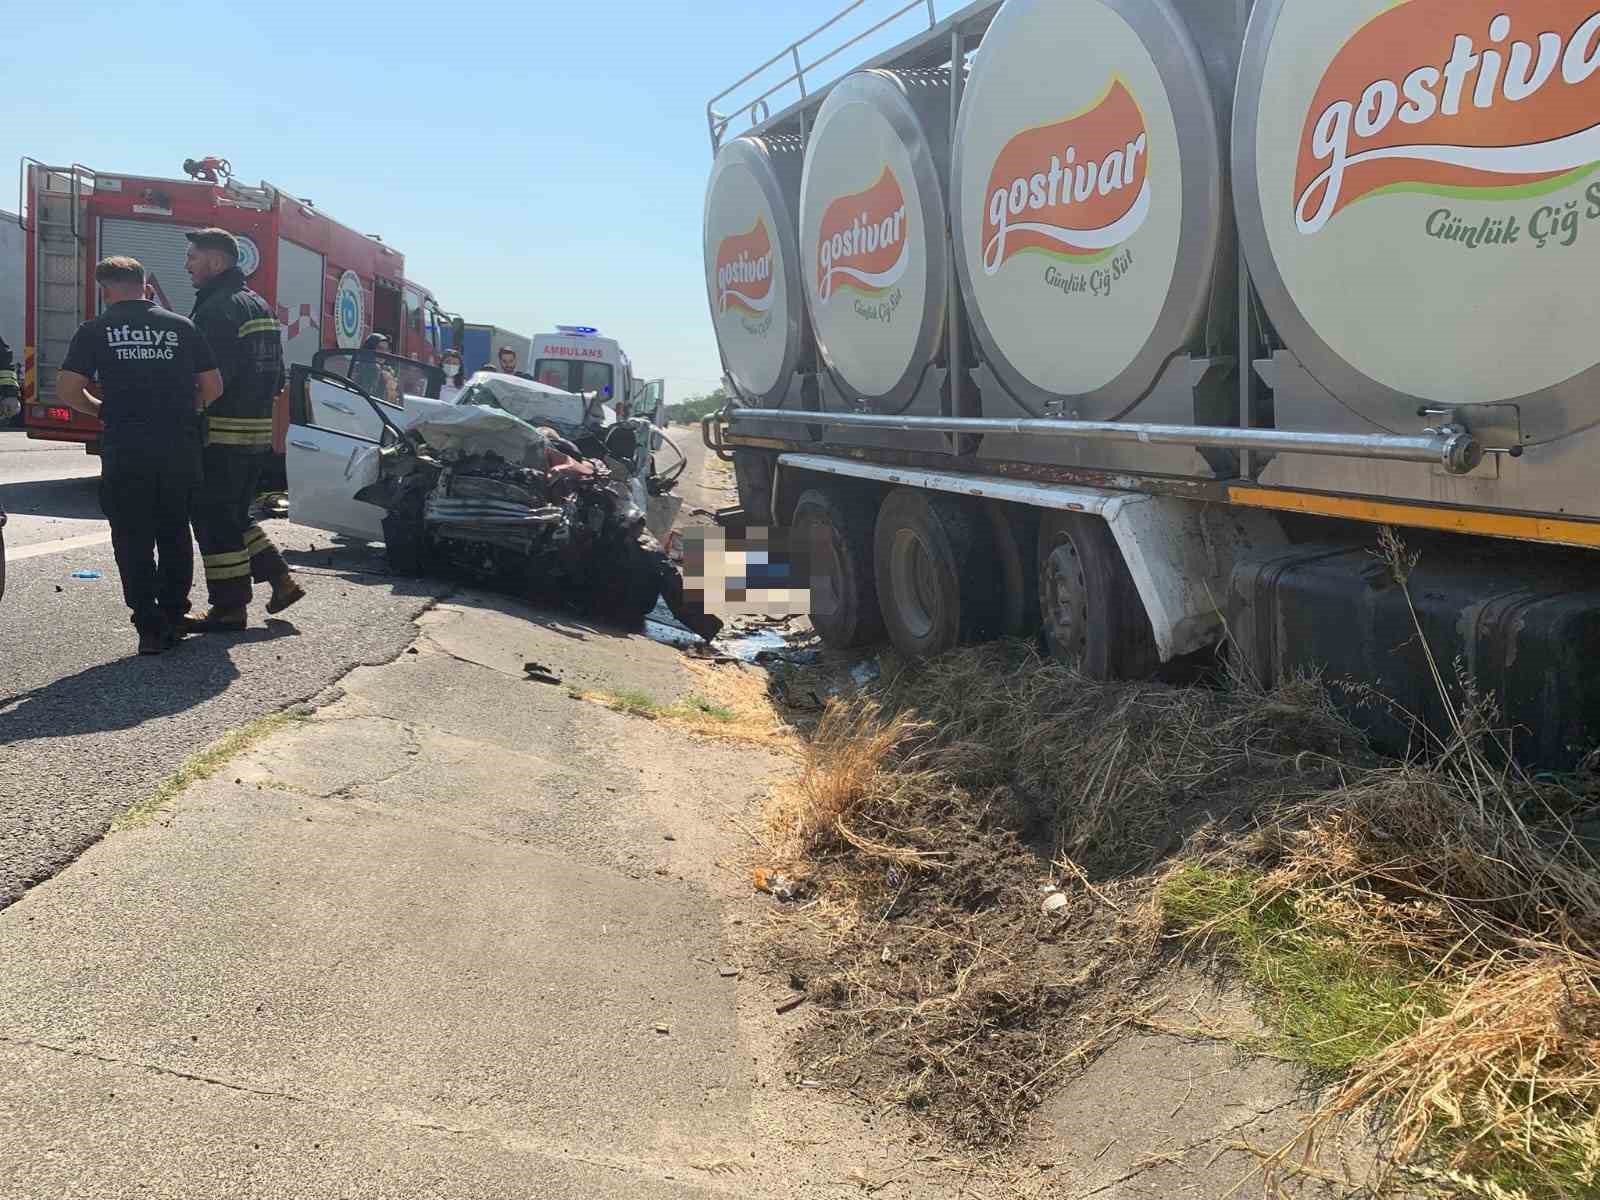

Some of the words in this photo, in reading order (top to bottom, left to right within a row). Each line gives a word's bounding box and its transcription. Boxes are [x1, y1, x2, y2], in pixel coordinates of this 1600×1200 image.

[1295, 11, 1600, 235] gostiva
[983, 132, 1146, 276] gostivar
[1425, 208, 1521, 249] Günlük
[1528, 200, 1579, 249] Çiğ
[820, 206, 905, 304] gostivar
[1044, 266, 1087, 294] Günlük
[1089, 265, 1111, 296] Çiğ
[1112, 249, 1134, 281] Süt
[718, 252, 772, 312] gostivar
[105, 325, 179, 346] itfaiye
[116, 345, 174, 360] TEKİRDAĞ
[543, 344, 603, 359] AMBULANS
